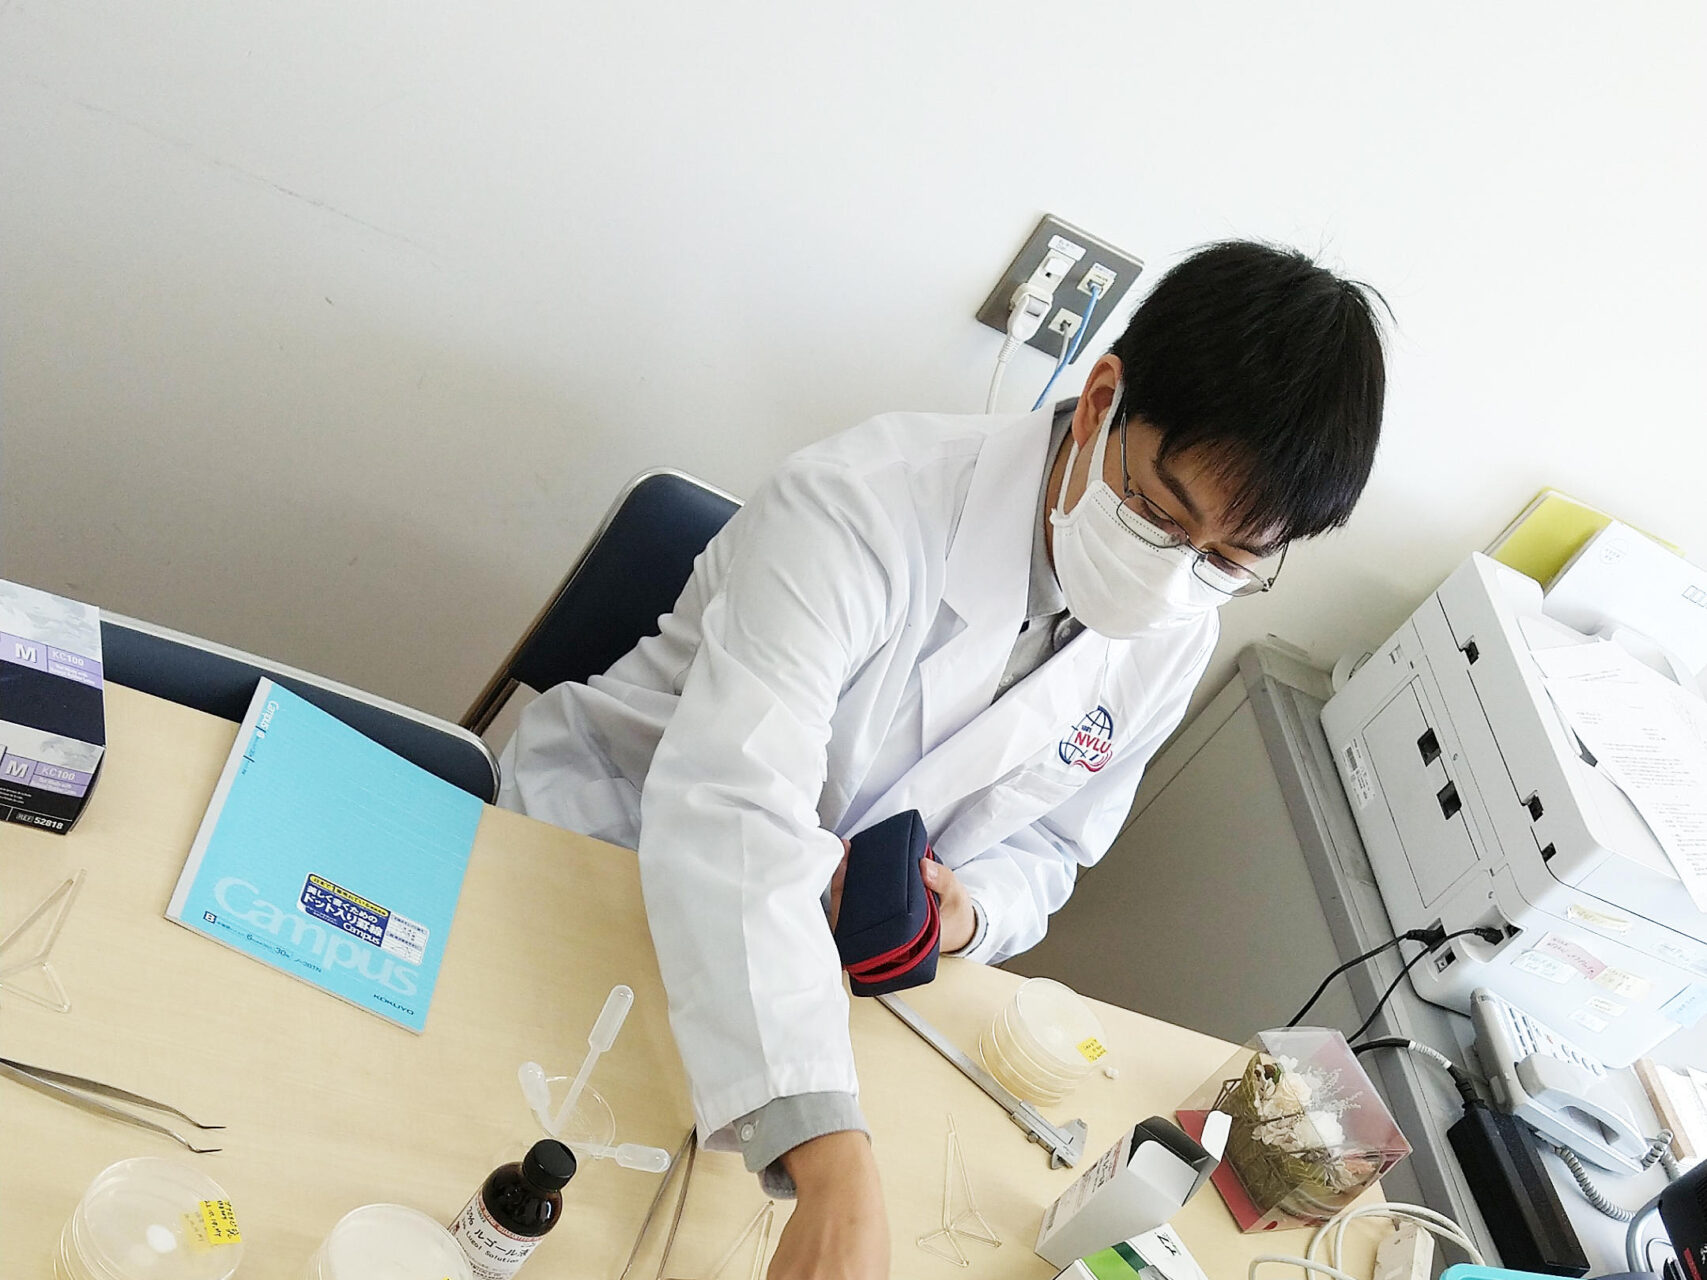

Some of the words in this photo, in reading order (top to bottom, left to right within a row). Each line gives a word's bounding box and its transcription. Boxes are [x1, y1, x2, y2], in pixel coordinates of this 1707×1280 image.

[15, 642, 37, 663] M
[52, 649, 85, 667] KC100
[1074, 731, 1112, 754] NVLU
[5, 759, 29, 779] M
[41, 765, 76, 781] KC100
[34, 815, 64, 830] 52818
[214, 877, 419, 996] Campus
[342, 922, 381, 946] Campus
[373, 994, 415, 1016] KOKUYO
